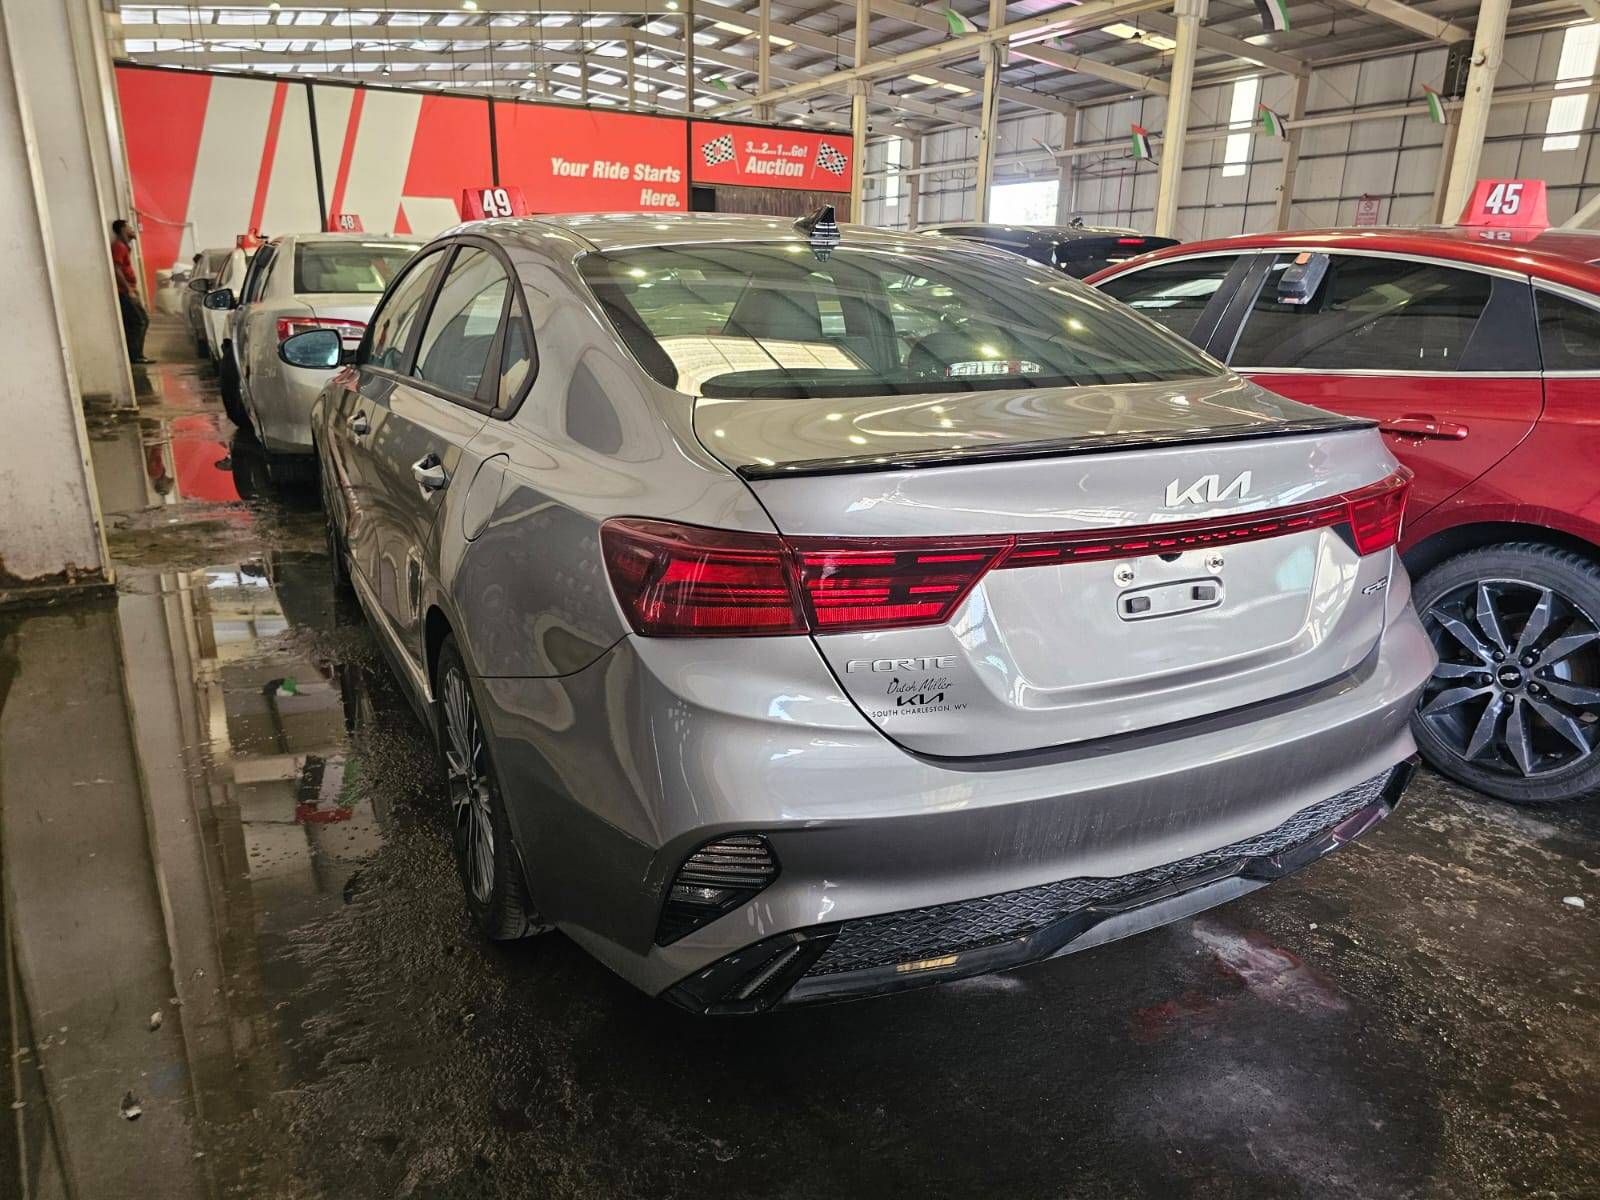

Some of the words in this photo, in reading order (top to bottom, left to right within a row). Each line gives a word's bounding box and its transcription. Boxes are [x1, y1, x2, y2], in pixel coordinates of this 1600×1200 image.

[551, 157, 589, 178] Your
[592, 160, 630, 180] Ride
[633, 164, 681, 183] Starts
[745, 156, 804, 177] Auction
[482, 189, 513, 217] 49
[640, 188, 680, 207] Here.
[1485, 183, 1523, 215] 45
[341, 215, 354, 230] 48
[1165, 470, 1252, 507] KIA
[846, 654, 958, 673] FORTE
[887, 678, 917, 695] Dutch
[918, 677, 952, 693] Miller
[897, 692, 944, 707] KIA
[872, 709, 899, 718] SOUTH
